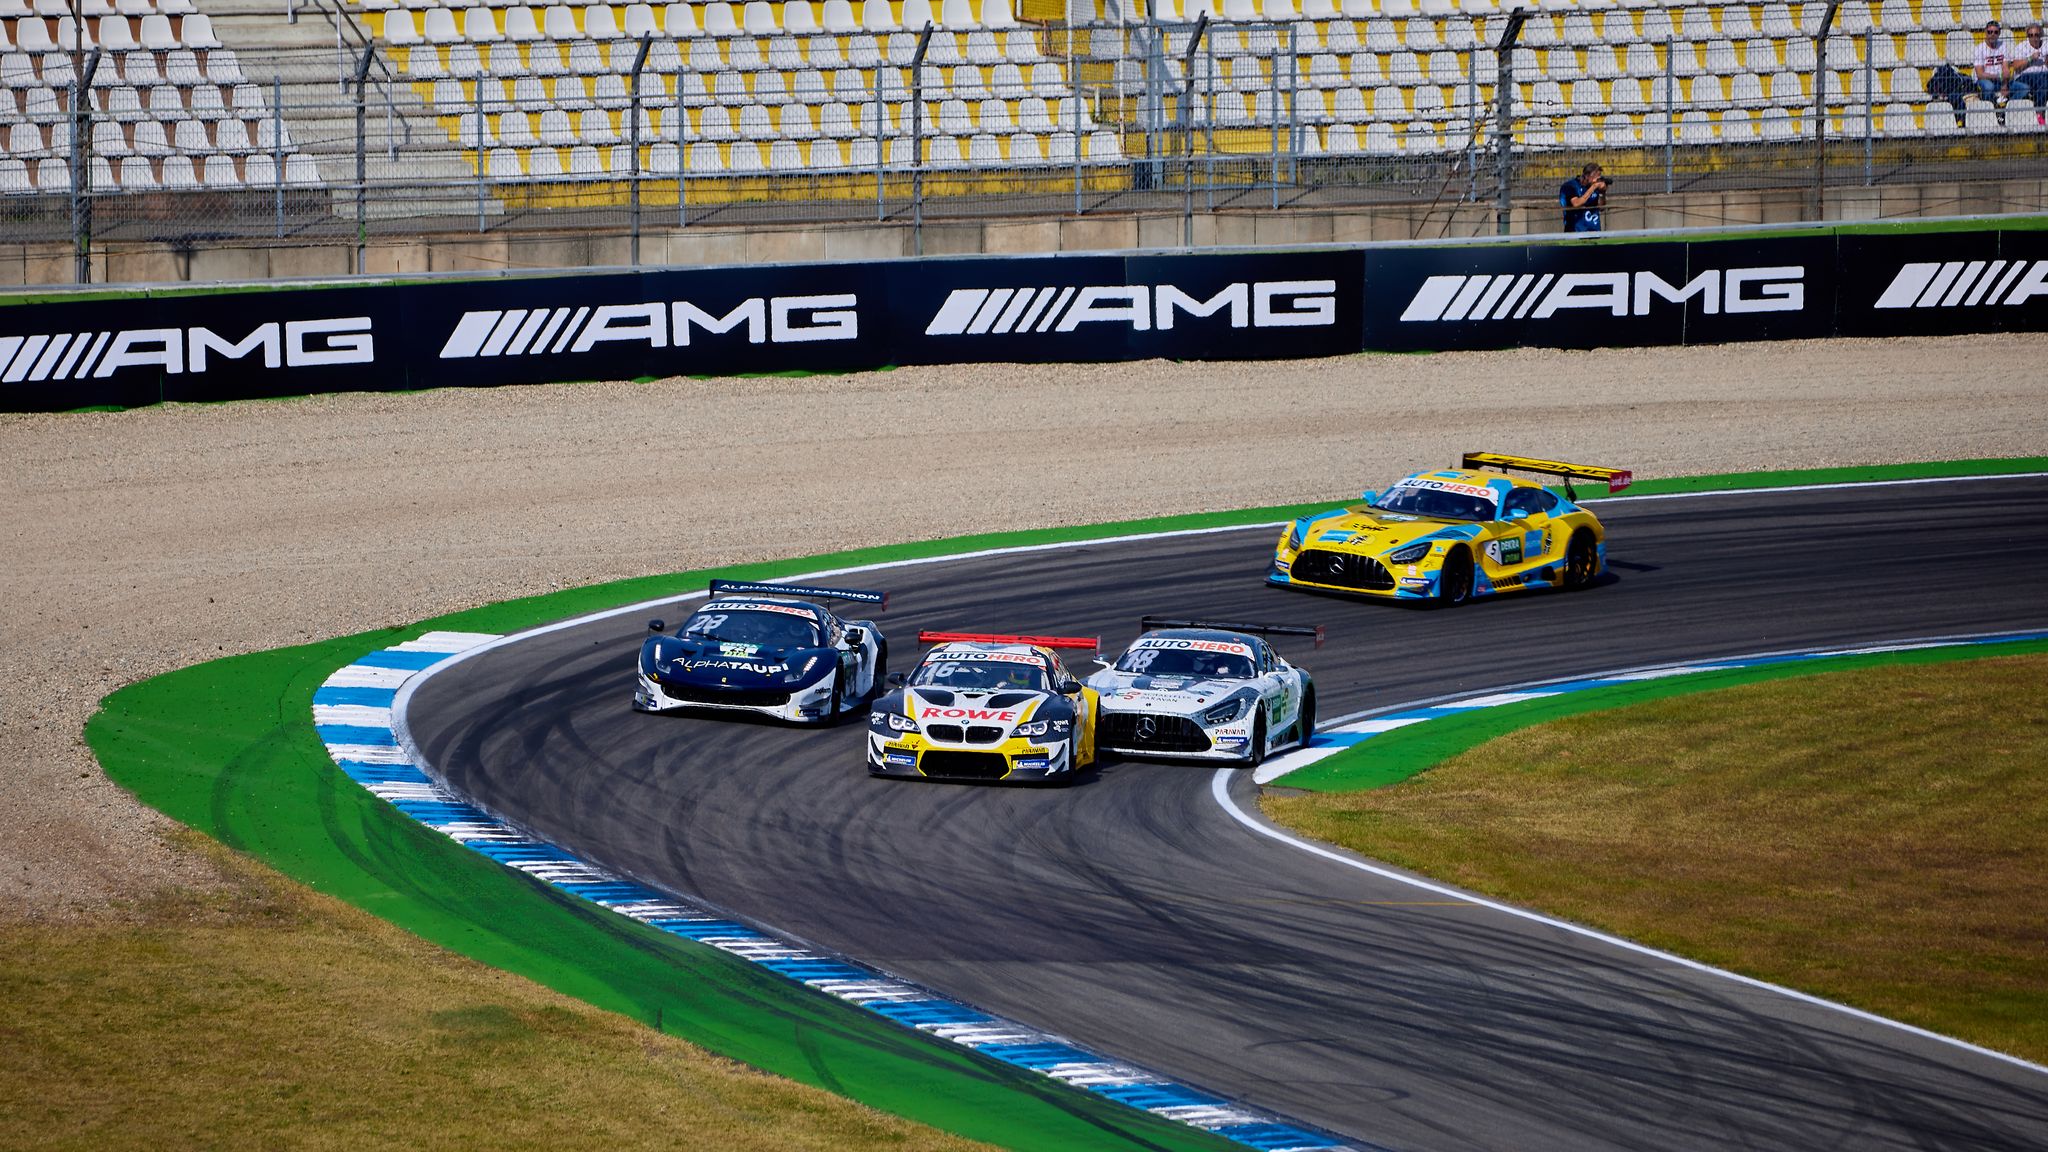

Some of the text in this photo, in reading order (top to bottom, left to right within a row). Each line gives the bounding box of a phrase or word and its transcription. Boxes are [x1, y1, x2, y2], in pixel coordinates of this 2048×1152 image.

[1531, 265, 1805, 319] AMG
[1055, 280, 1336, 332] AMG
[570, 293, 858, 353] AMG
[93, 316, 374, 379] AMG
[1402, 479, 1490, 497] AUTOHERO
[1490, 541, 1498, 556] 5
[1500, 538, 1520, 551] DEKRA
[707, 602, 812, 617] AUTOHERO
[687, 613, 729, 632] 28
[1139, 640, 1245, 653] AUTOHERO
[672, 657, 789, 674] ALPHATAURI
[938, 652, 1042, 664] AUTOHERO
[1123, 649, 1161, 670] 18
[926, 660, 961, 683] 16
[921, 707, 1017, 722] ROWE
